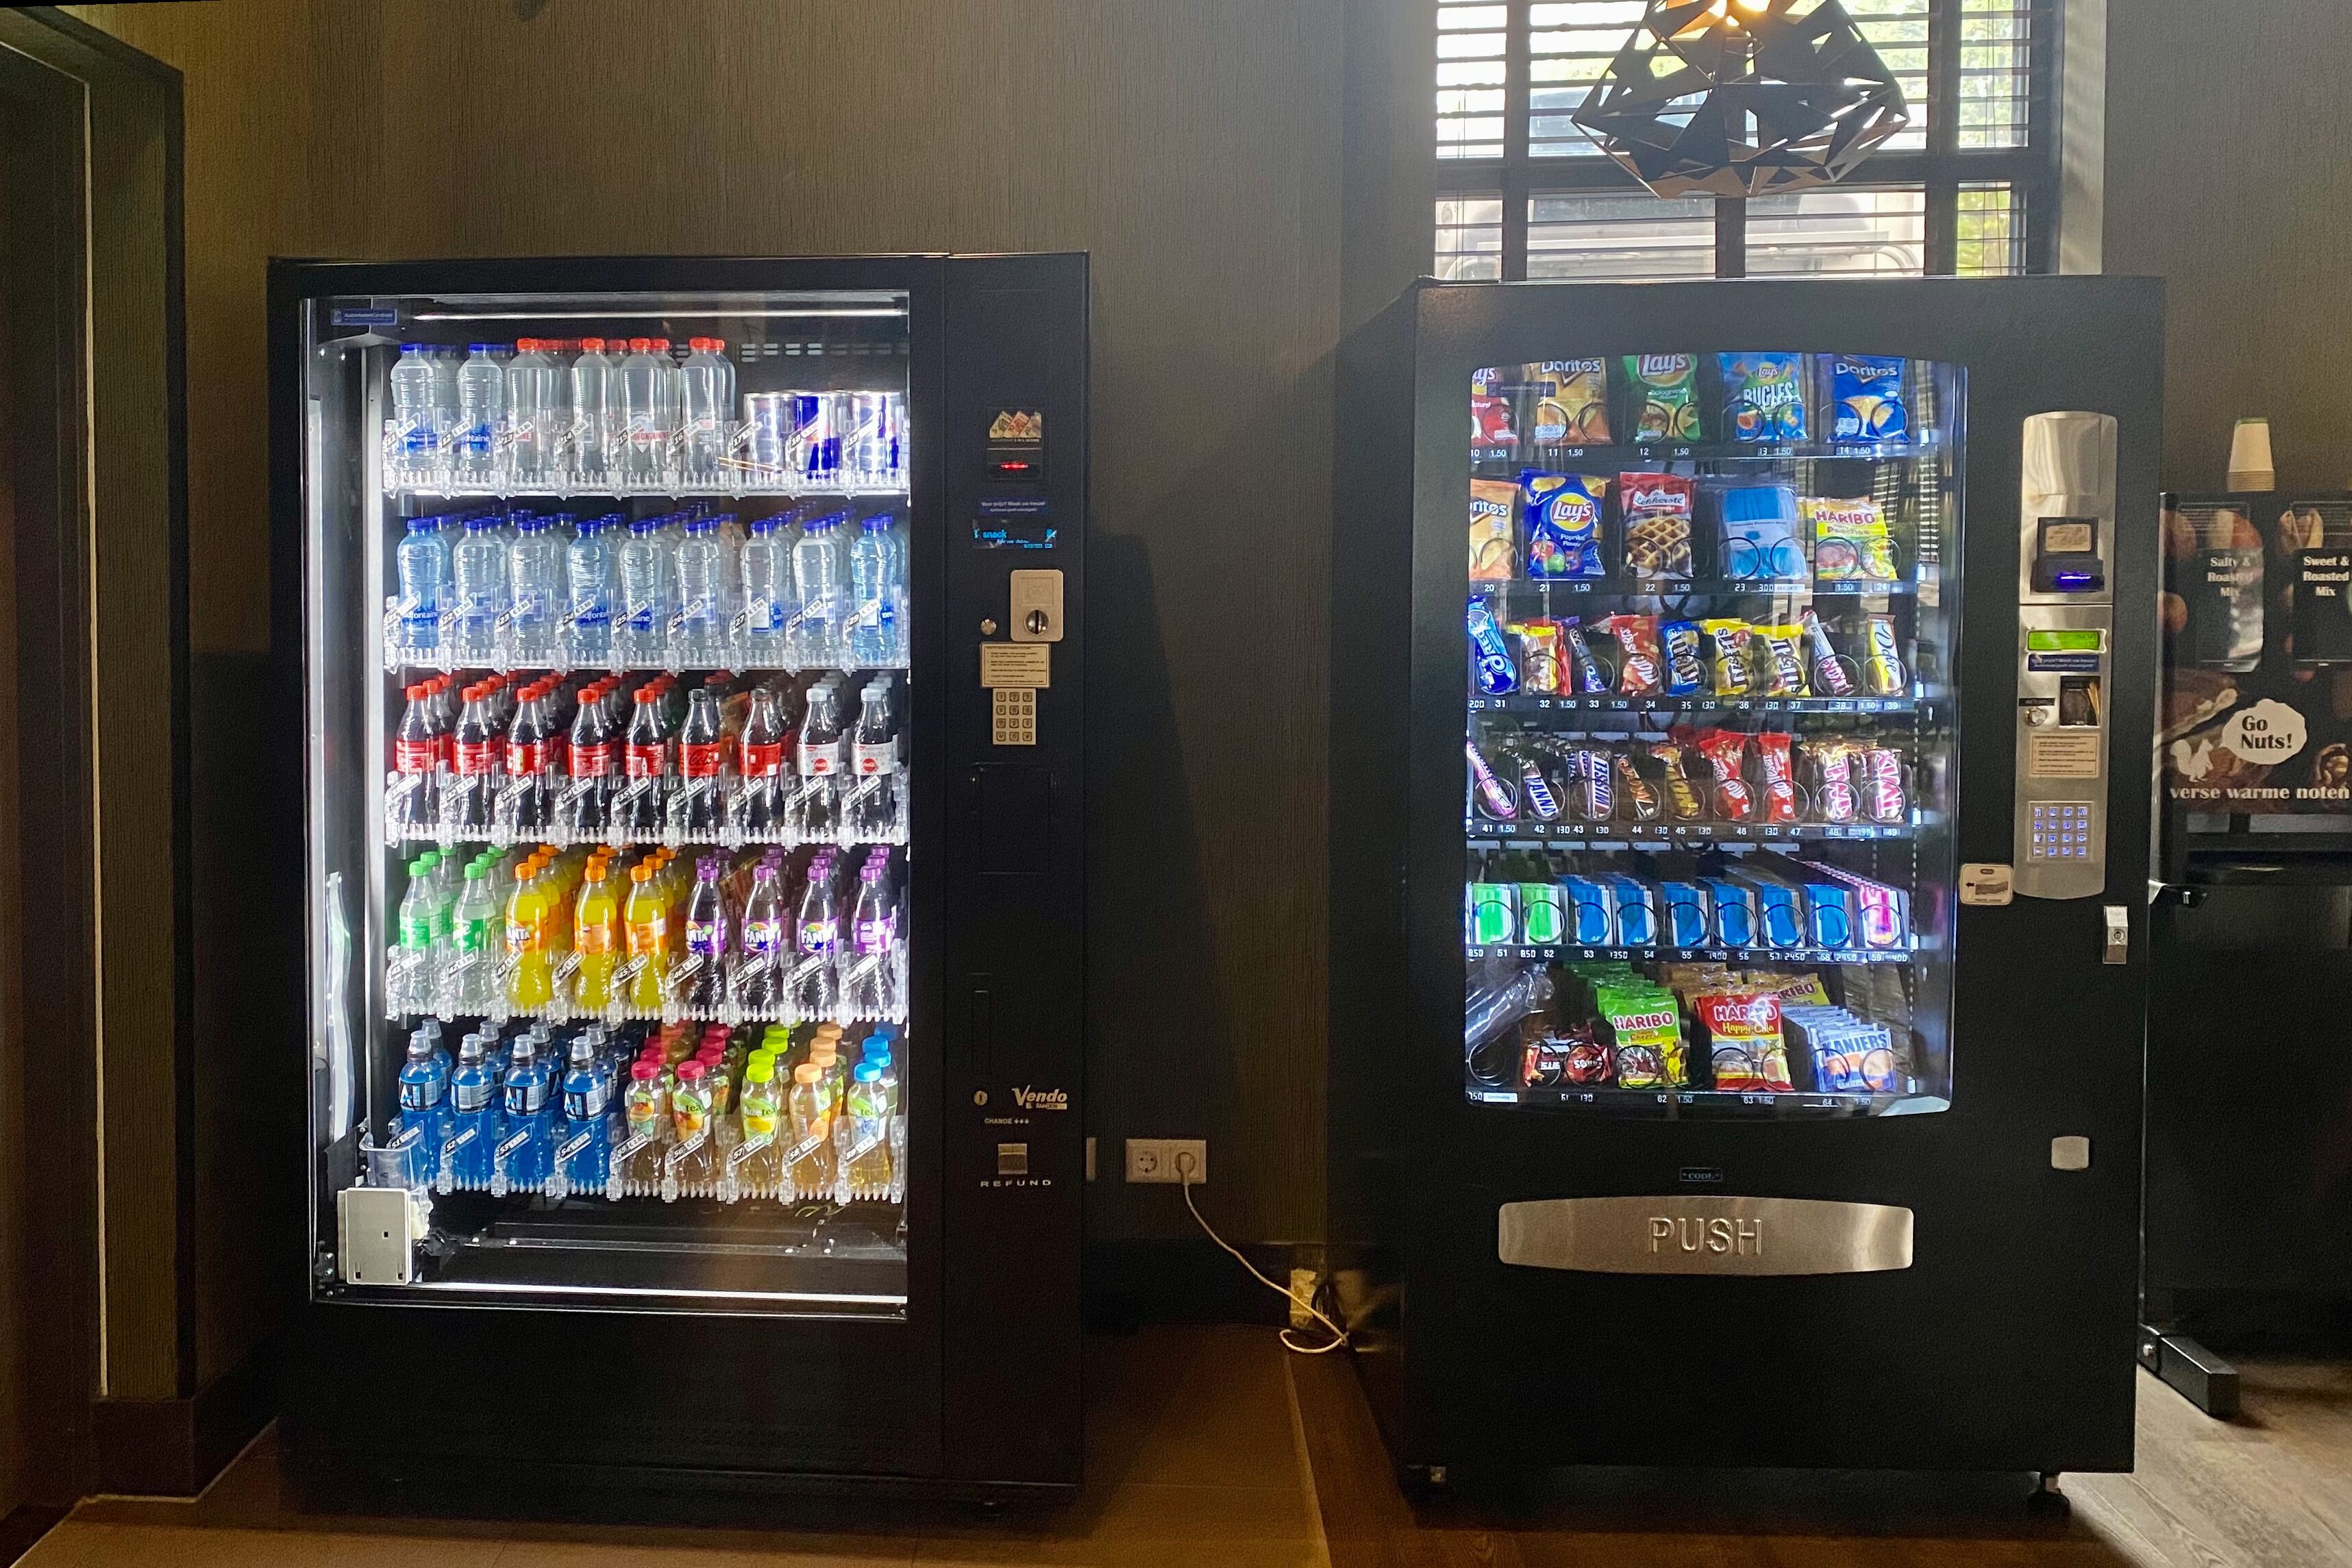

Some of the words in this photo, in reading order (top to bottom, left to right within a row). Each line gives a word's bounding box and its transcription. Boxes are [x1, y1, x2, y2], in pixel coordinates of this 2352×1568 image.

[1542, 360, 1600, 373] Doritos
[1836, 363, 1898, 376] Doritos
[1743, 382, 1794, 410] BUGLES
[1490, 449, 1507, 458] 1.50
[1548, 448, 1559, 456] 11
[1568, 448, 1583, 456] 1.50
[1470, 501, 1507, 516] ritos
[1553, 503, 1594, 521] Lay's
[1815, 510, 1877, 526] HARIBO
[2210, 556, 2238, 567] Salty
[2242, 557, 2251, 567] &
[2303, 556, 2337, 567] Sweet
[2340, 556, 2350, 567] &
[2207, 571, 2253, 582] Roasted
[2303, 571, 2350, 582] Roasted
[1574, 584, 1590, 592] 1.50
[1645, 584, 1655, 592] 22
[1735, 583, 1746, 592] 23
[2220, 587, 2240, 597] Mix
[2316, 586, 2336, 596] Mix
[617, 614, 626, 623] 25
[735, 614, 745, 625] 27
[791, 614, 802, 624] 28
[1560, 701, 1576, 709] 1.50
[1589, 700, 1600, 708] 33
[1646, 700, 1656, 708] 34
[1790, 701, 1801, 709] 37
[2242, 715, 2268, 732] Go
[2241, 733, 2292, 749] Nuts!
[1594, 759, 1609, 808] WISSEL
[2170, 788, 2220, 799] verse
[2227, 788, 2290, 799] warme
[2296, 787, 2351, 799] noten
[1482, 825, 1493, 833] 41
[1676, 826, 1686, 834] 45
[1584, 950, 1594, 958] 53
[1681, 951, 1692, 959] 55
[1714, 1004, 1778, 1021] HARO
[1613, 1011, 1675, 1030] HARIBO
[1822, 1034, 1887, 1058] KANJERS
[1011, 1084, 1067, 1106] Vendo
[1649, 1217, 1762, 1255] PUSH
